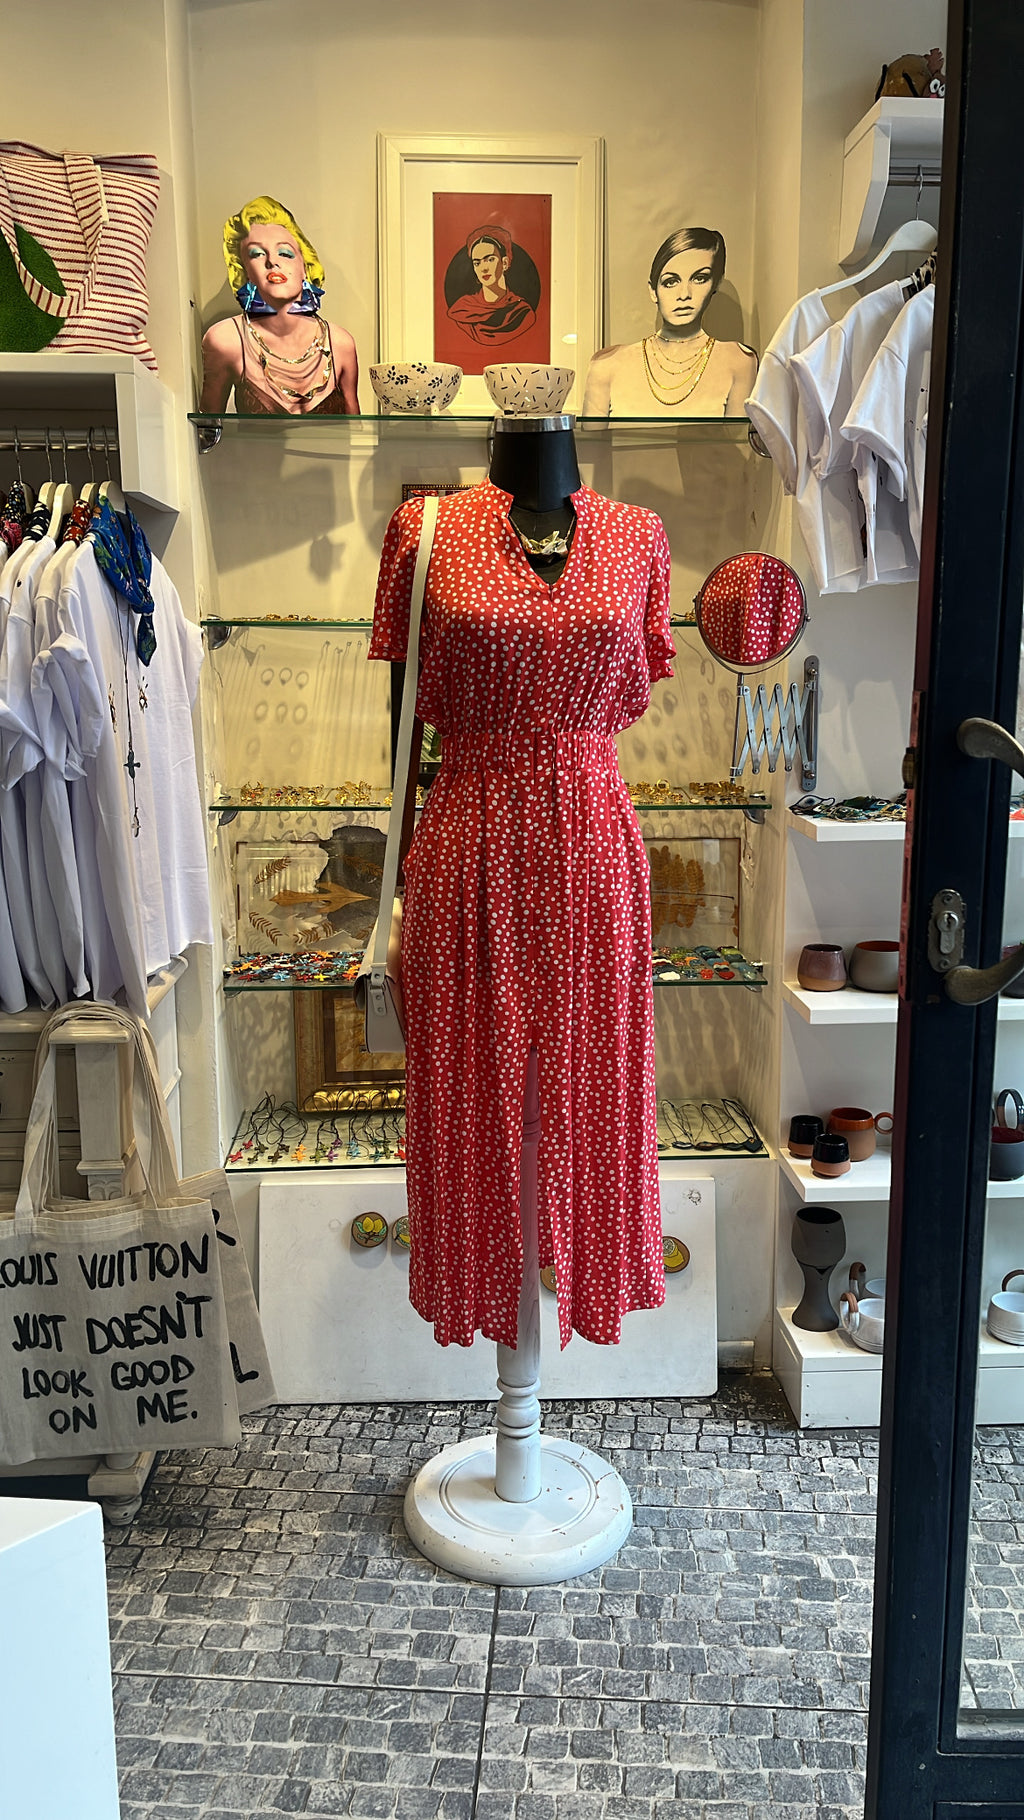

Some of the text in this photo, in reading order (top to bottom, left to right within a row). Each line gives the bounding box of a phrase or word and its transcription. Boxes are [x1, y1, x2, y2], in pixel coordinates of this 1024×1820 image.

[78, 1233, 209, 1290] VUITTON
[12, 1291, 213, 1355] JUST DOESN'T
[22, 1354, 195, 1400] LOOK GOOD
[49, 1389, 198, 1434] ON ME.
